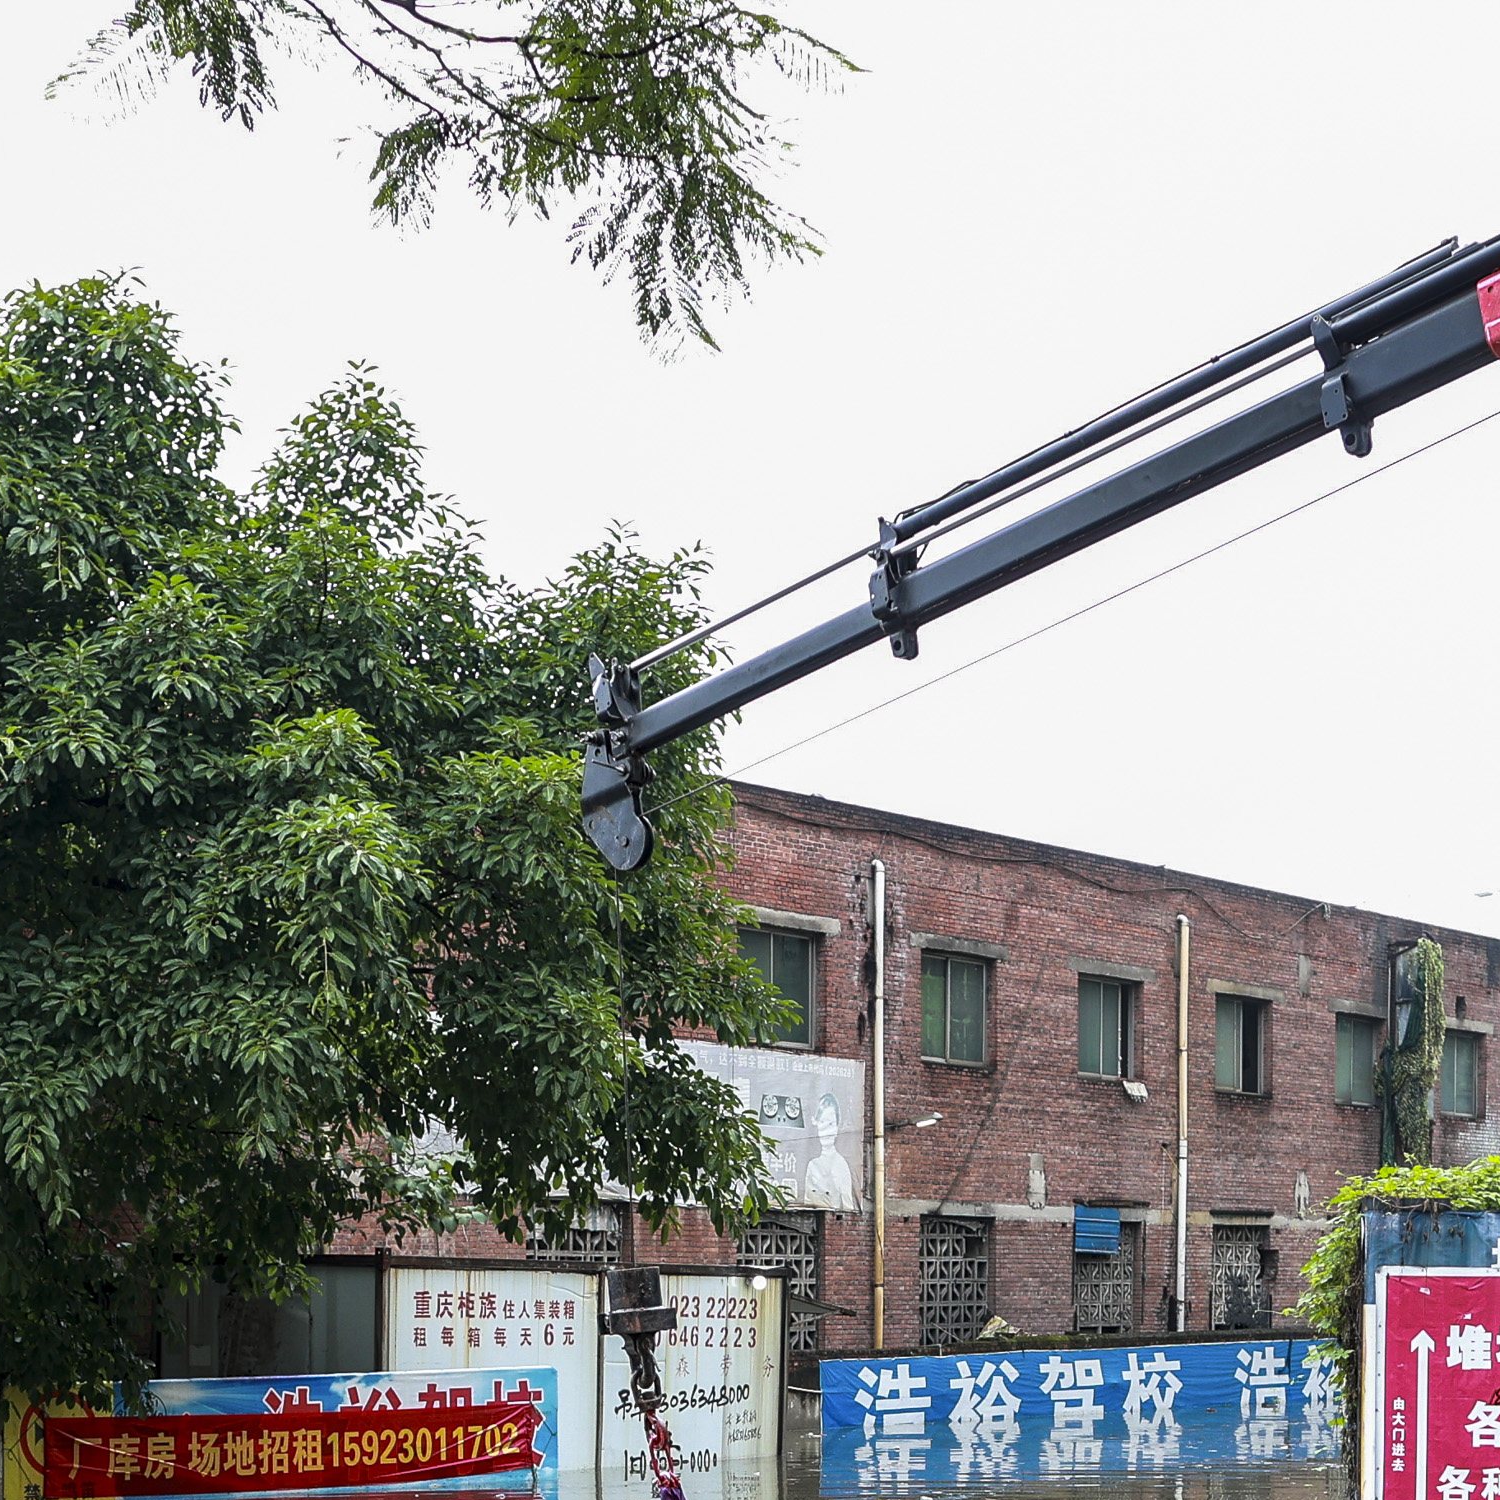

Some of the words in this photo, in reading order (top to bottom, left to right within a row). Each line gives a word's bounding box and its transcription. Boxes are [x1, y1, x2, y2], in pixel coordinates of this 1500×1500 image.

[413, 1290, 497, 1320] 重庆柜族
[502, 1299, 576, 1320] 住人集装箱
[413, 1323, 575, 1348] 租每箱每天6元
[854, 1351, 1184, 1424] 浩裕驾校
[188, 1422, 521, 1480] 场地招租15923011702
[1391, 1396, 1406, 1472] 由大门进去
